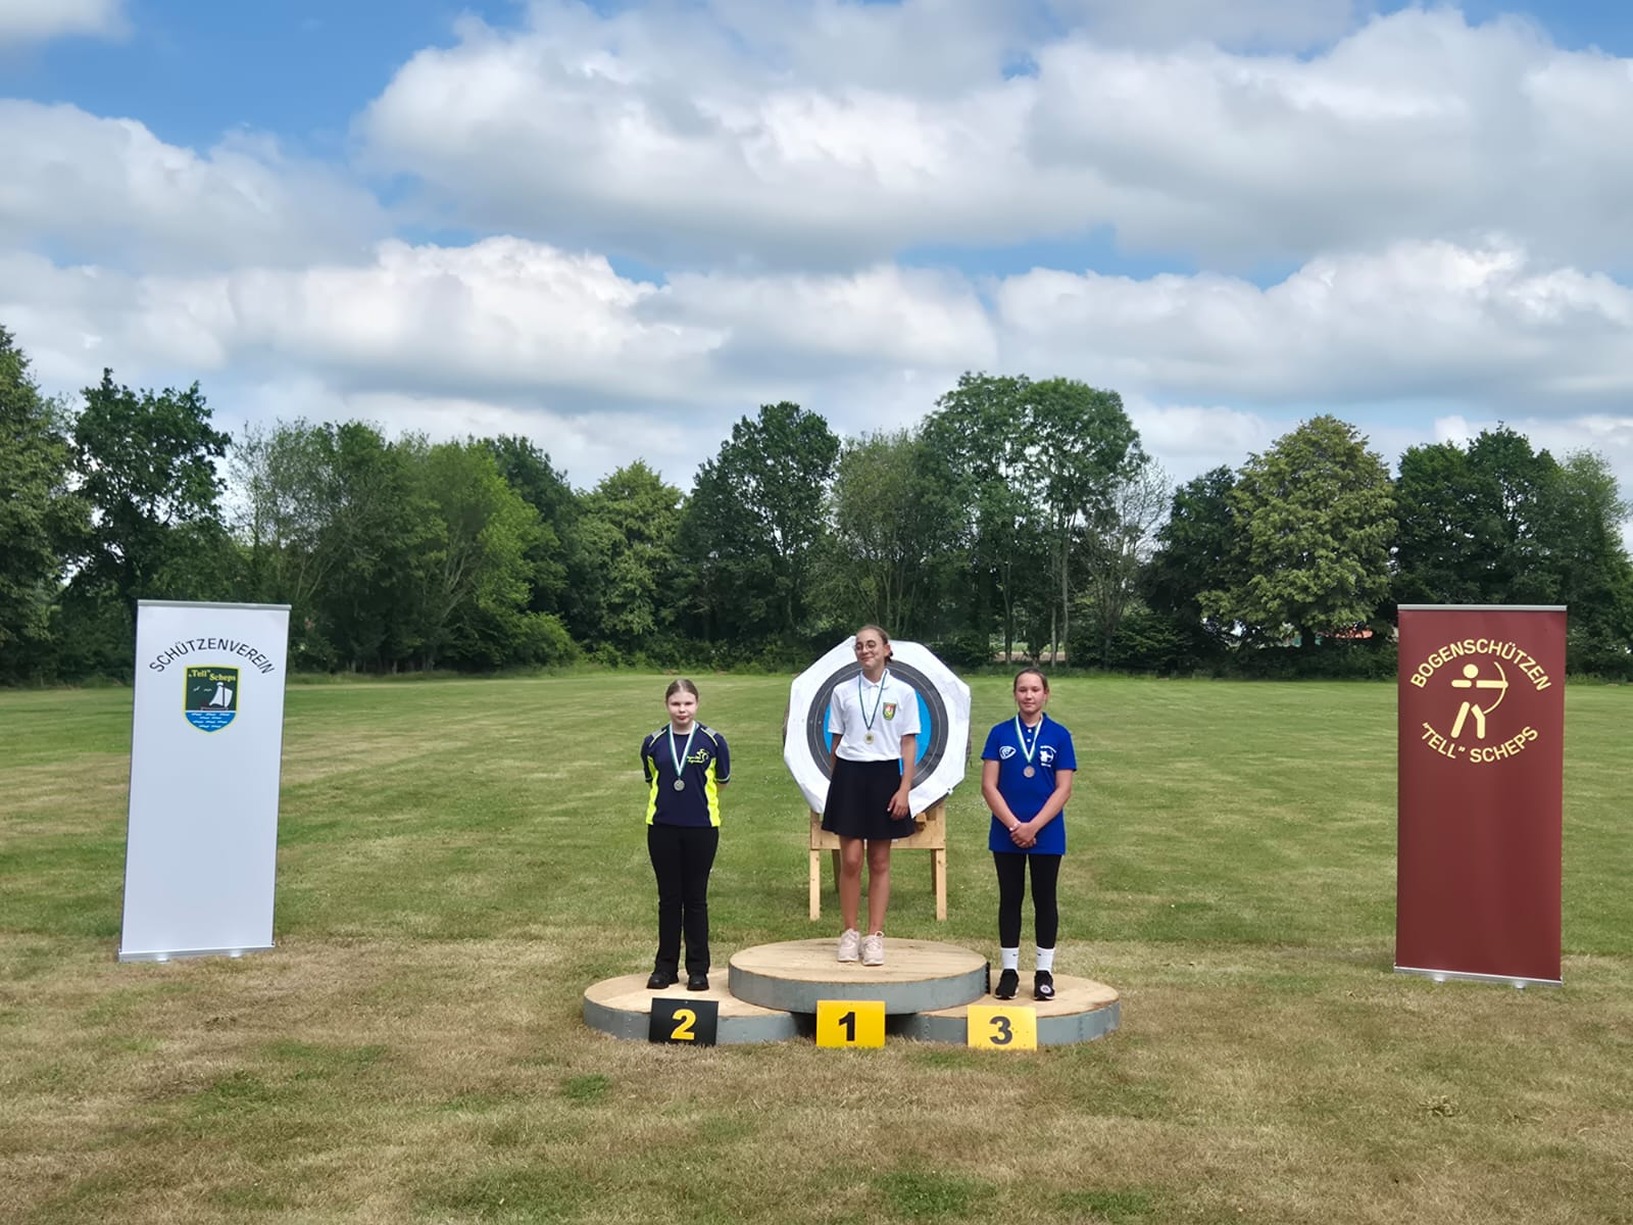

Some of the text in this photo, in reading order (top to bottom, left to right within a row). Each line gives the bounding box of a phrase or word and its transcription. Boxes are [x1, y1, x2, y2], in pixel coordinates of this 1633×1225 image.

[149, 638, 275, 674] SCHÜTZENVEREIN
[1410, 637, 1551, 691] BOGENSCHÜTZEN
[1470, 726, 1539, 763] SCHEPS
[670, 1009, 695, 1040] 2
[838, 1011, 856, 1041] 1
[989, 1016, 1013, 1045] 3
